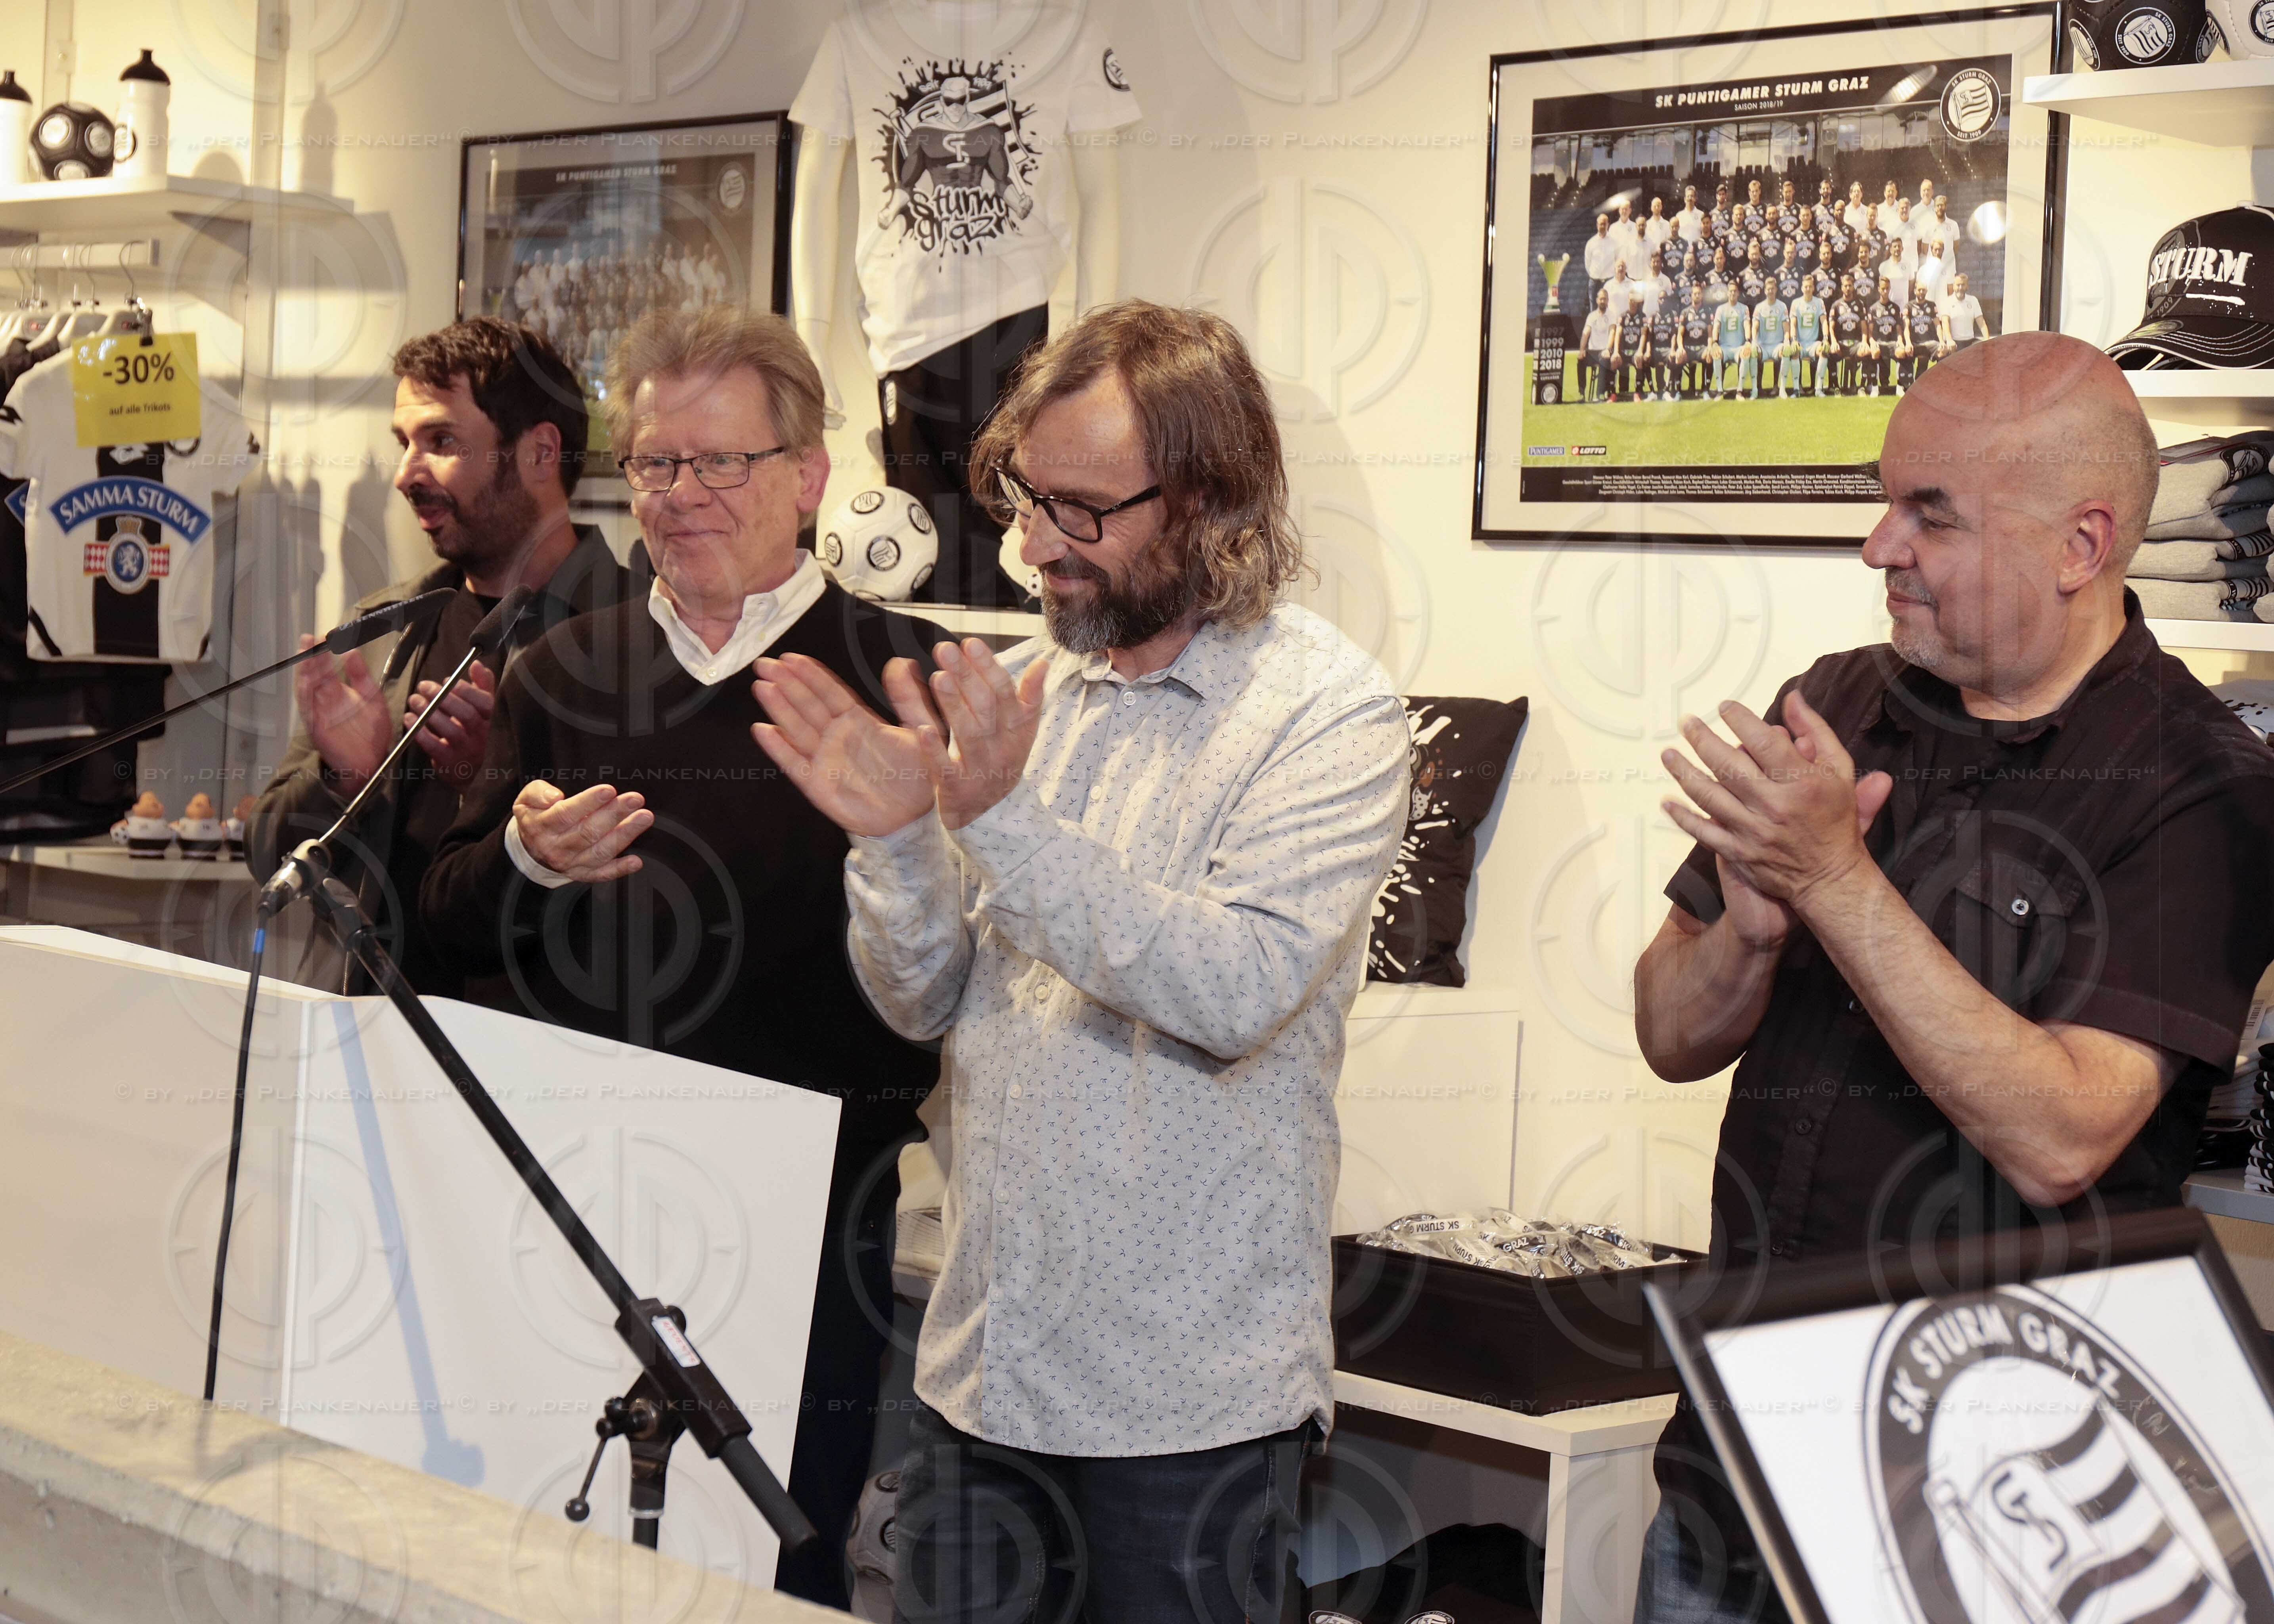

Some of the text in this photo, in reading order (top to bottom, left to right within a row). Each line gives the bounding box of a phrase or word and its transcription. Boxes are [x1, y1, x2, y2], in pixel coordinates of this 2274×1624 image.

[2162, 16, 2173, 32] STURM
[2121, 44, 2130, 56] 1909
[1951, 71, 1992, 87] SK STURM GRAZ
[1656, 76, 1869, 108] SK PUNTIGAMER STURM GRAZ
[1734, 100, 1784, 111] SAISON 2018/19
[1957, 129, 1981, 139] SEIT 1909
[2149, 247, 2253, 289] STURM
[2157, 297, 2173, 314] 1909
[1541, 337, 1564, 347] 1999
[1540, 348, 1563, 358] 2010
[103, 352, 174, 385] -30%
[1539, 359, 1562, 370] 2018
[109, 402, 170, 416] auf alle Trikots
[59, 485, 199, 534] SAMMA STURM
[1416, 1222, 1445, 1233] STURM
[1503, 1237, 1529, 1252] GRAZ
[1887, 1304, 2124, 1434] SK STURM GRAZ
